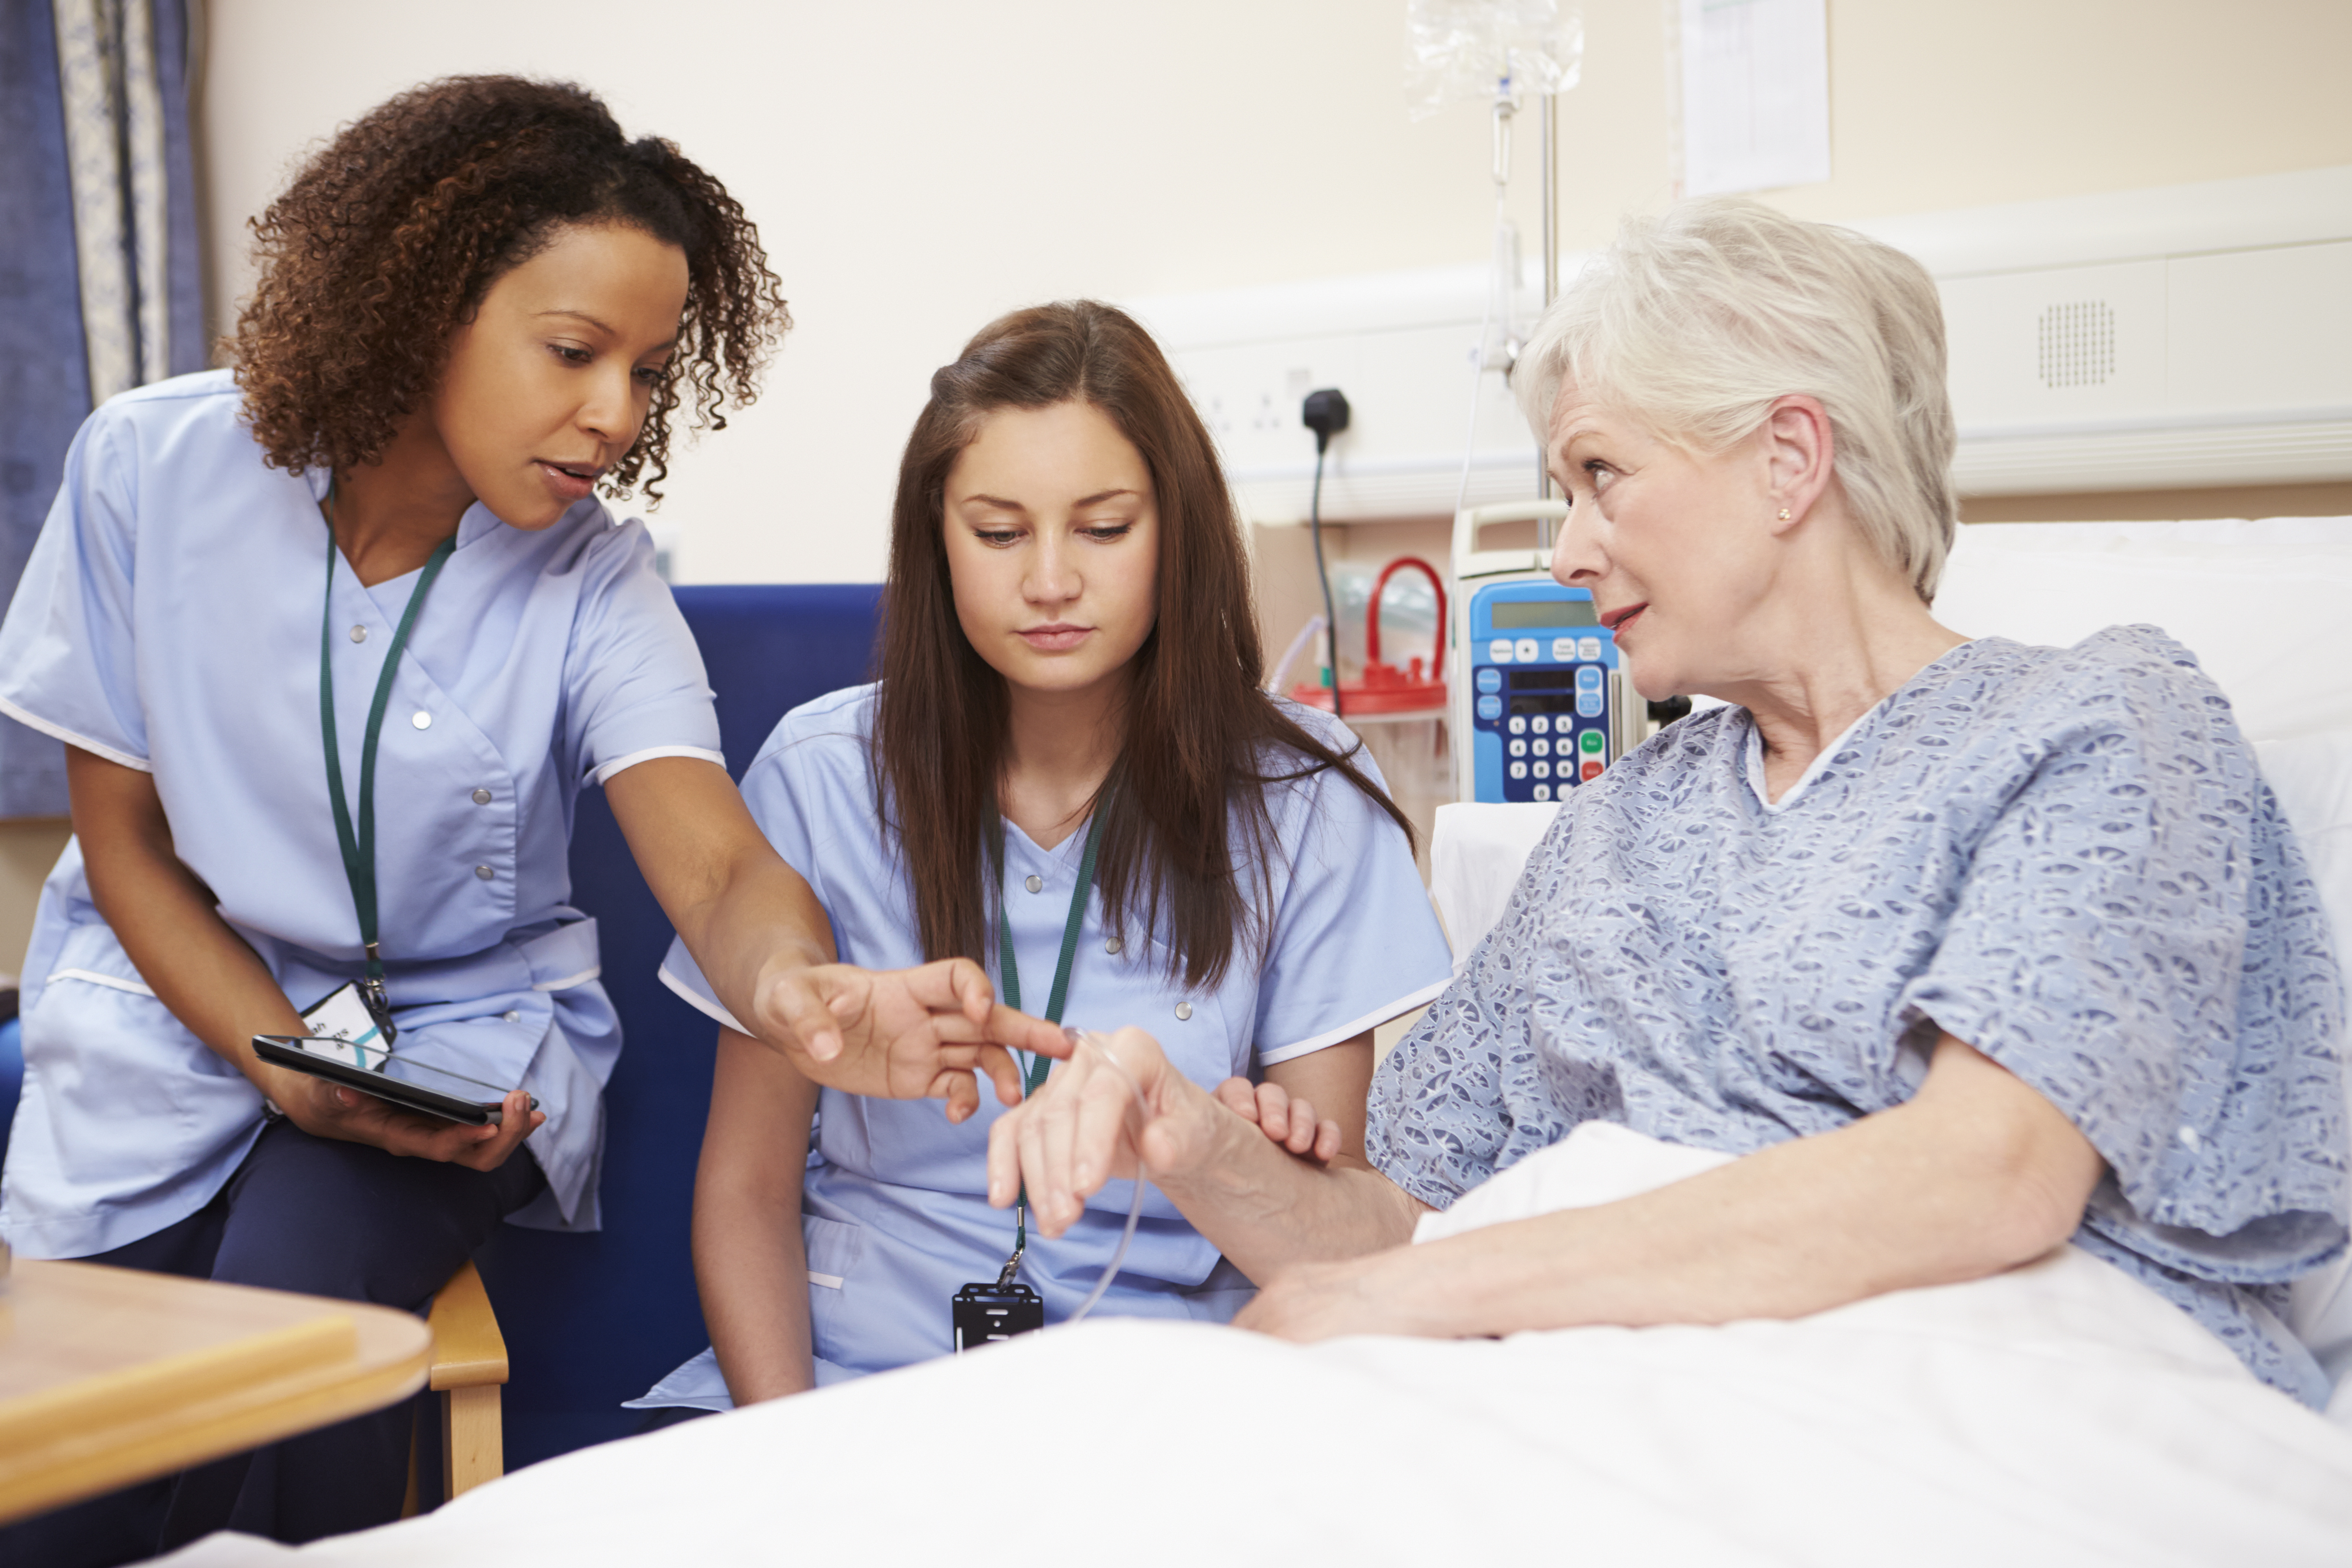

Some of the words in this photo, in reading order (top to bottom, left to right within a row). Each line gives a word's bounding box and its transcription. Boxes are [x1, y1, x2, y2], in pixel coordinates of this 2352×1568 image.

[1537, 721, 1544, 730] 2
[1562, 720, 1567, 730] 3
[1514, 745, 1521, 753] 4
[1538, 744, 1544, 753] 5
[1562, 743, 1568, 752] 6
[1516, 766, 1522, 775] 7
[1539, 766, 1544, 774] 8
[1562, 765, 1568, 774] 9
[1539, 789, 1545, 798] 0
